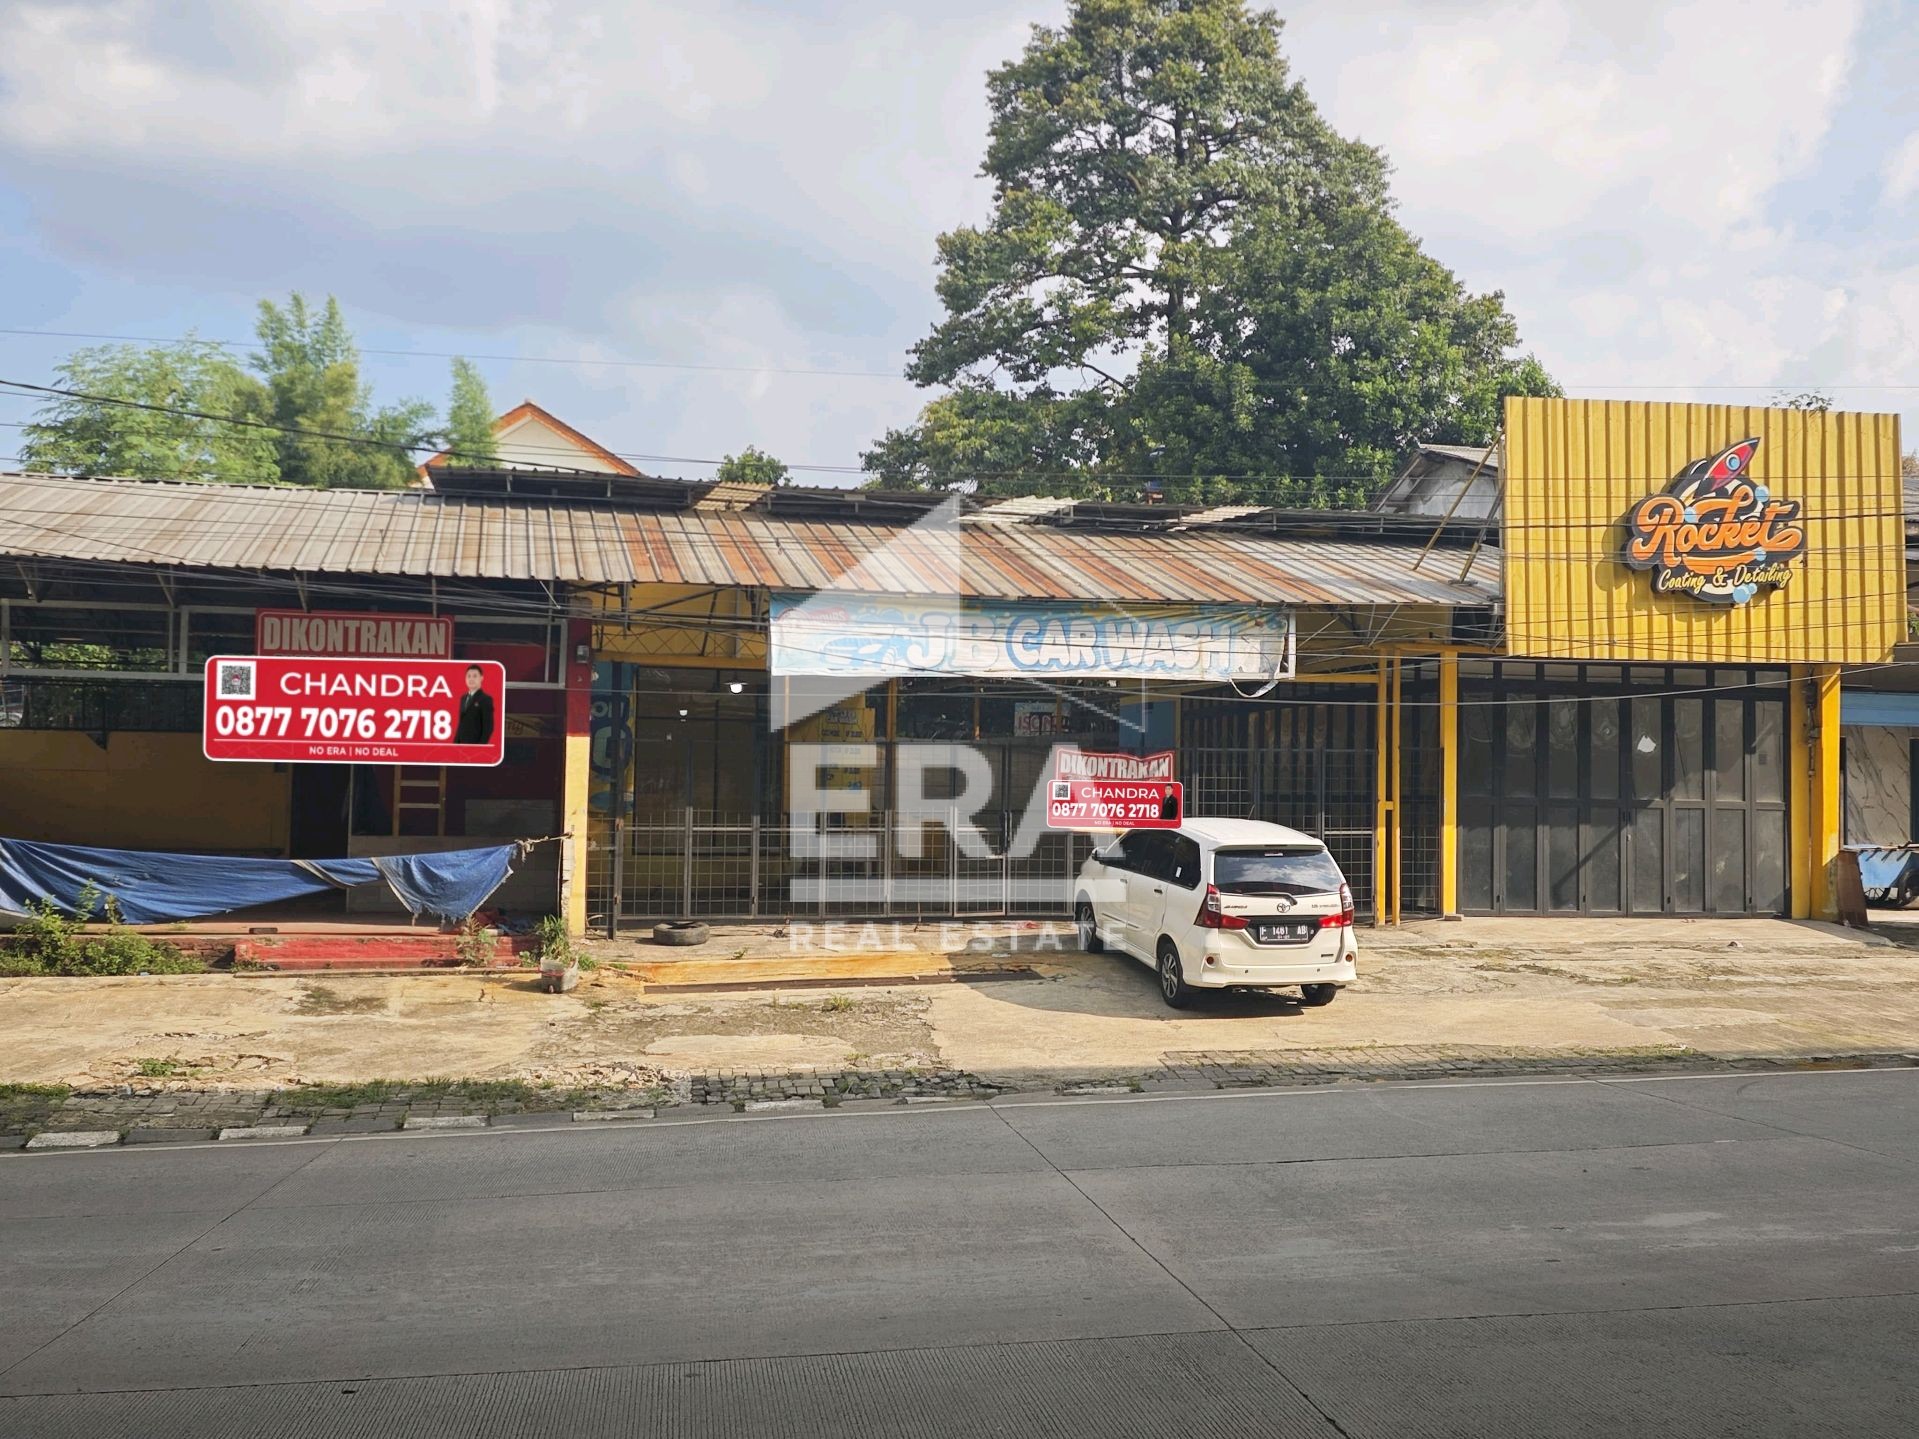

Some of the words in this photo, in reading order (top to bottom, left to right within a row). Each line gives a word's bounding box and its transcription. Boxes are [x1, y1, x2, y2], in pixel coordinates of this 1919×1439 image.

[1632, 485, 1802, 568] Rocket
[1659, 569, 1706, 594] Coating
[1712, 566, 1728, 585] &
[1734, 562, 1792, 588] Detailing
[263, 616, 446, 656] DIKONTRAKAN
[1006, 613, 1098, 671] CAR
[1101, 615, 1231, 674] WASH
[1060, 753, 1170, 779] DIKONTRAKAN
